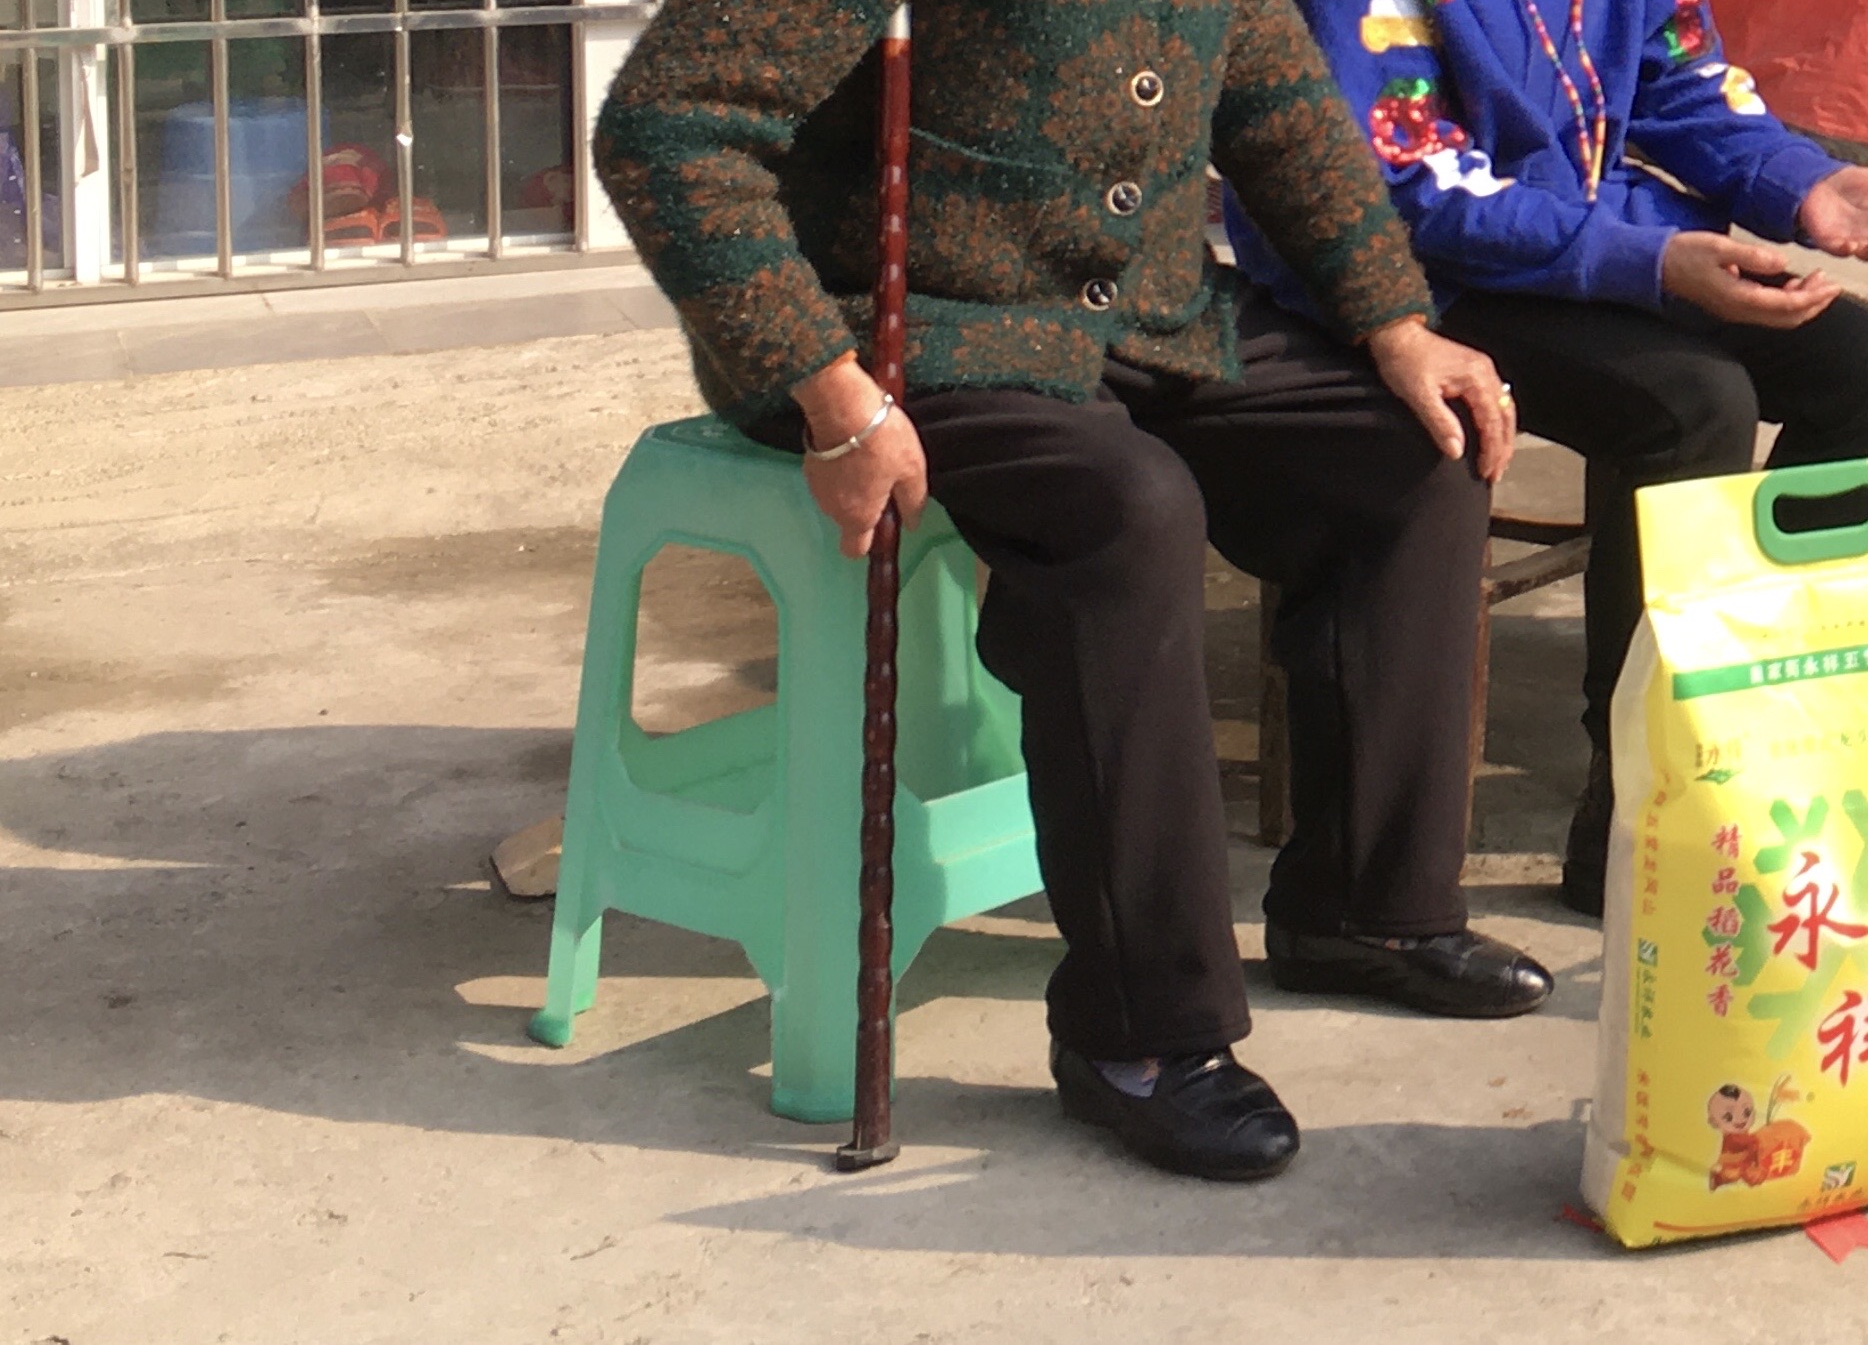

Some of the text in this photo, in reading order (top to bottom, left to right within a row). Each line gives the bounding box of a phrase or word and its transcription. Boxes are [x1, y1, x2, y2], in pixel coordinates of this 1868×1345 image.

[1705, 825, 1743, 1017] 精品稻花香
